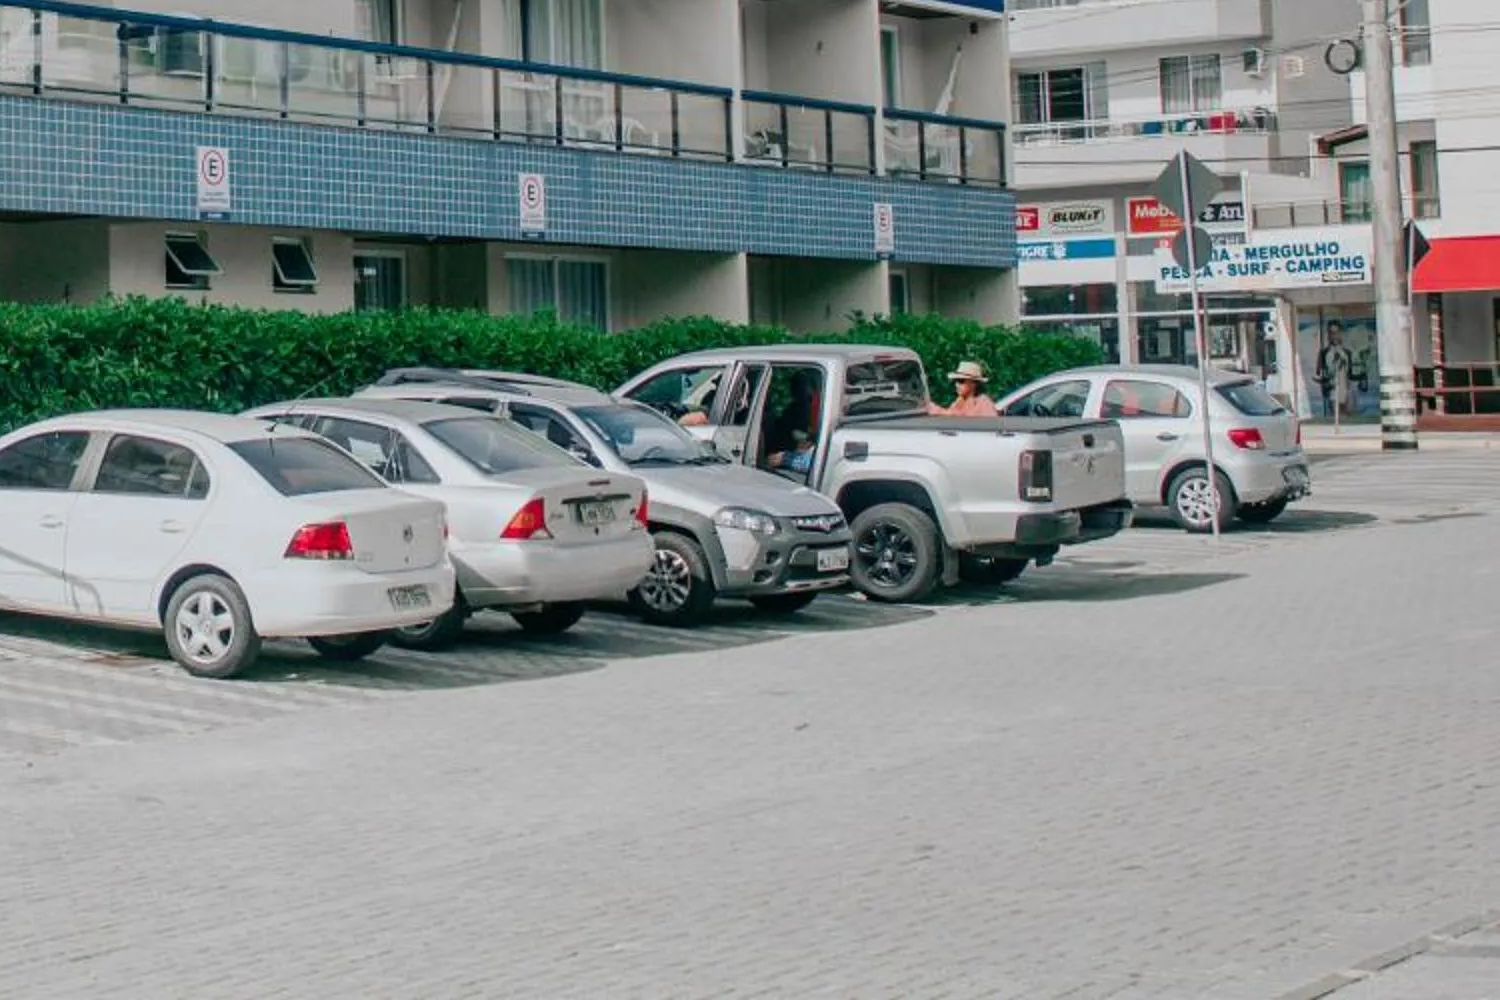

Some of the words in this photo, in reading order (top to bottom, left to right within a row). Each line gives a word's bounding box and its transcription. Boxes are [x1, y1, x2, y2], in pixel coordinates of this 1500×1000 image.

[209, 158, 218, 177] E
[527, 184, 537, 201] E
[1245, 241, 1340, 261] MERGULHO
[1161, 264, 1213, 280] PESA
[1227, 262, 1270, 277] SURF
[1286, 255, 1365, 274] CAMPING
